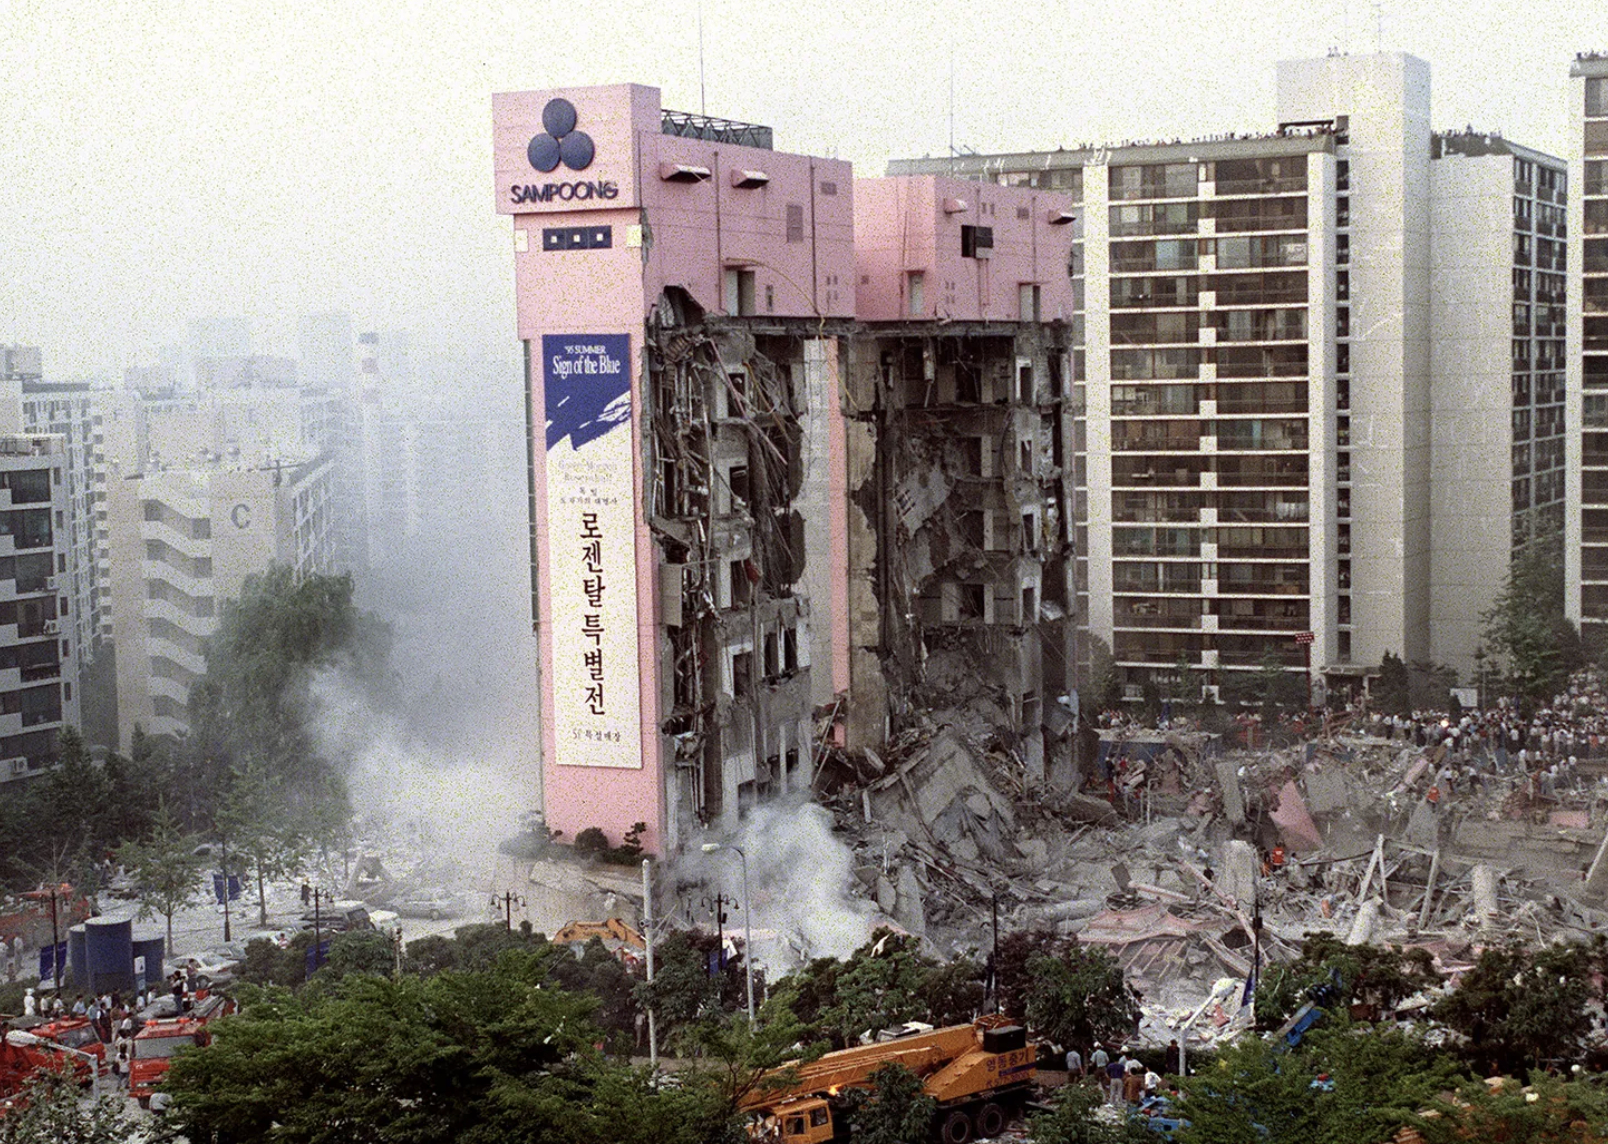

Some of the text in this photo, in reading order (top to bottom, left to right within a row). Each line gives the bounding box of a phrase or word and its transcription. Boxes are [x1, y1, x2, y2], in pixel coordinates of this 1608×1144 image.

[511, 180, 618, 204] SAMPOONG
[575, 344, 607, 355] SUMMER
[553, 355, 621, 379] Sign of the Blue
[230, 504, 251, 529] C
[580, 512, 606, 716] 로젠탈 특별전
